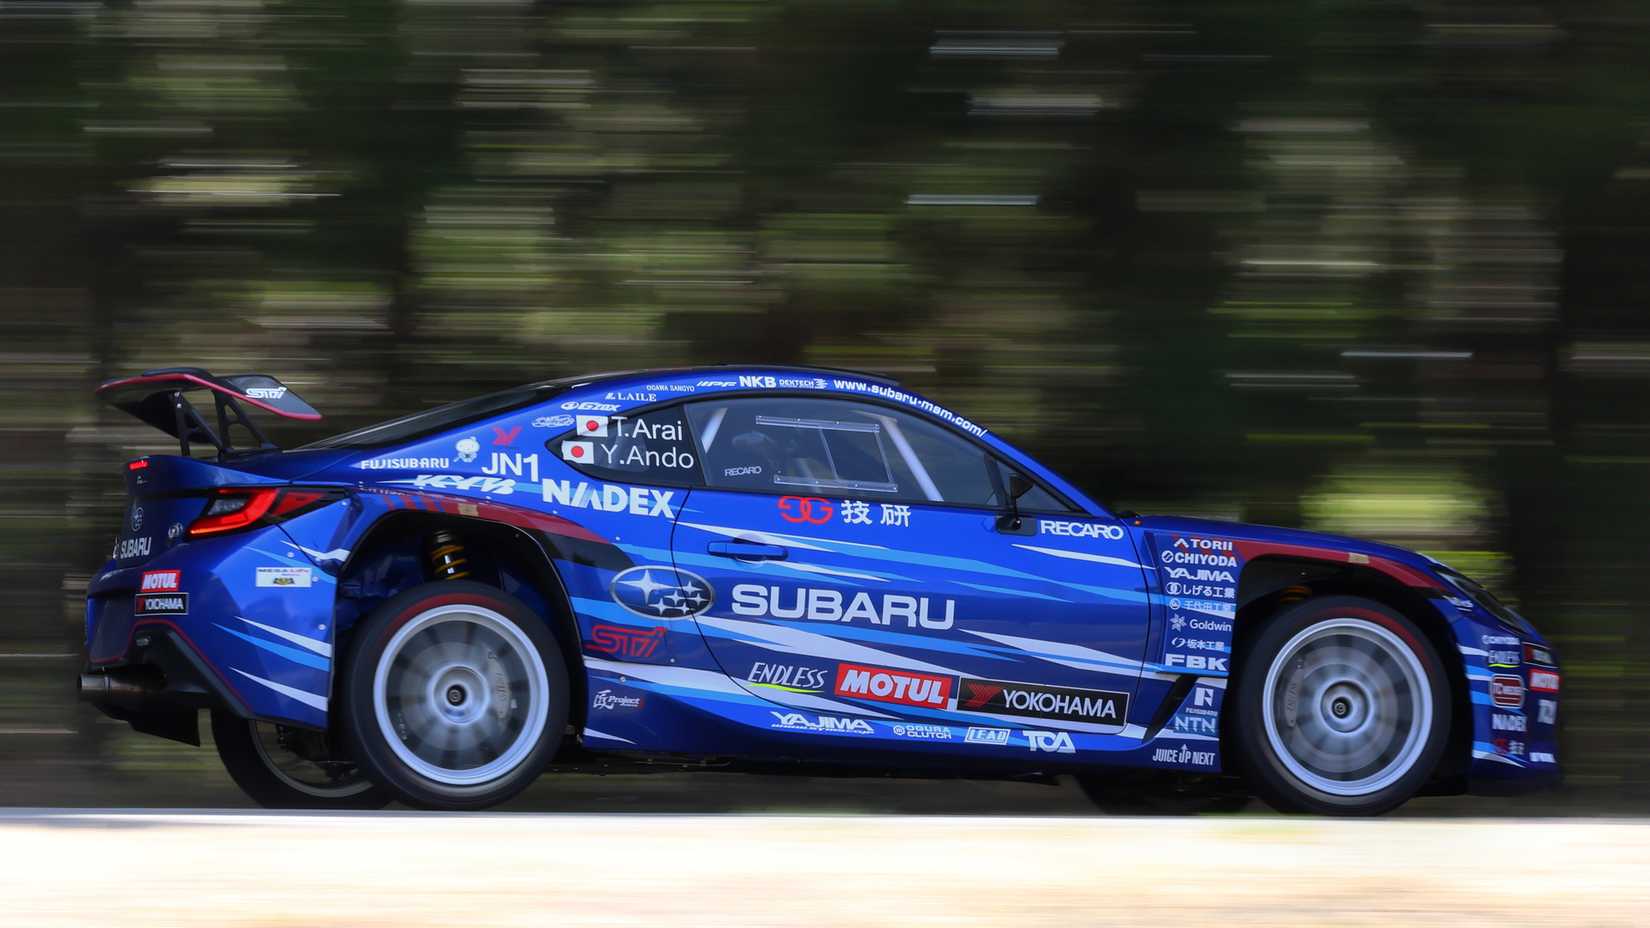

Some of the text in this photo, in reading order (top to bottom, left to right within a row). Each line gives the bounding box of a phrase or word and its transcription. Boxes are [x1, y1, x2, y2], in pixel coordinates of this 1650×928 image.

[739, 376, 776, 388] NKB
[617, 392, 657, 402] LAILE
[611, 416, 683, 441] T.Arai
[360, 457, 450, 469] FUJISUBARU
[600, 443, 694, 470] Y.Ando
[481, 453, 539, 482] JN1
[724, 466, 762, 477] RECARO
[413, 475, 517, 494] KYB
[542, 478, 676, 519] NADEX
[1040, 519, 1124, 540] RECARO
[120, 537, 152, 559] SUBARU
[1190, 538, 1233, 551] TORII
[1175, 552, 1237, 567] CHIYODA
[142, 573, 177, 590] MOTUL
[1164, 567, 1236, 583] YAJIMA
[731, 583, 955, 631] SUBARU
[1190, 618, 1232, 632] Goldwin
[1165, 653, 1227, 671] FBK
[748, 662, 828, 690] ENDLESS
[840, 669, 945, 705] MOTUL
[1003, 688, 1117, 719] YOKOHAMA
[770, 710, 874, 731] YAJIMA
[1174, 716, 1216, 733] NTN
[907, 731, 953, 740] CLUTCH
[968, 728, 1010, 744] LEAD
[1152, 745, 1216, 766] JUICE UP NEXT
